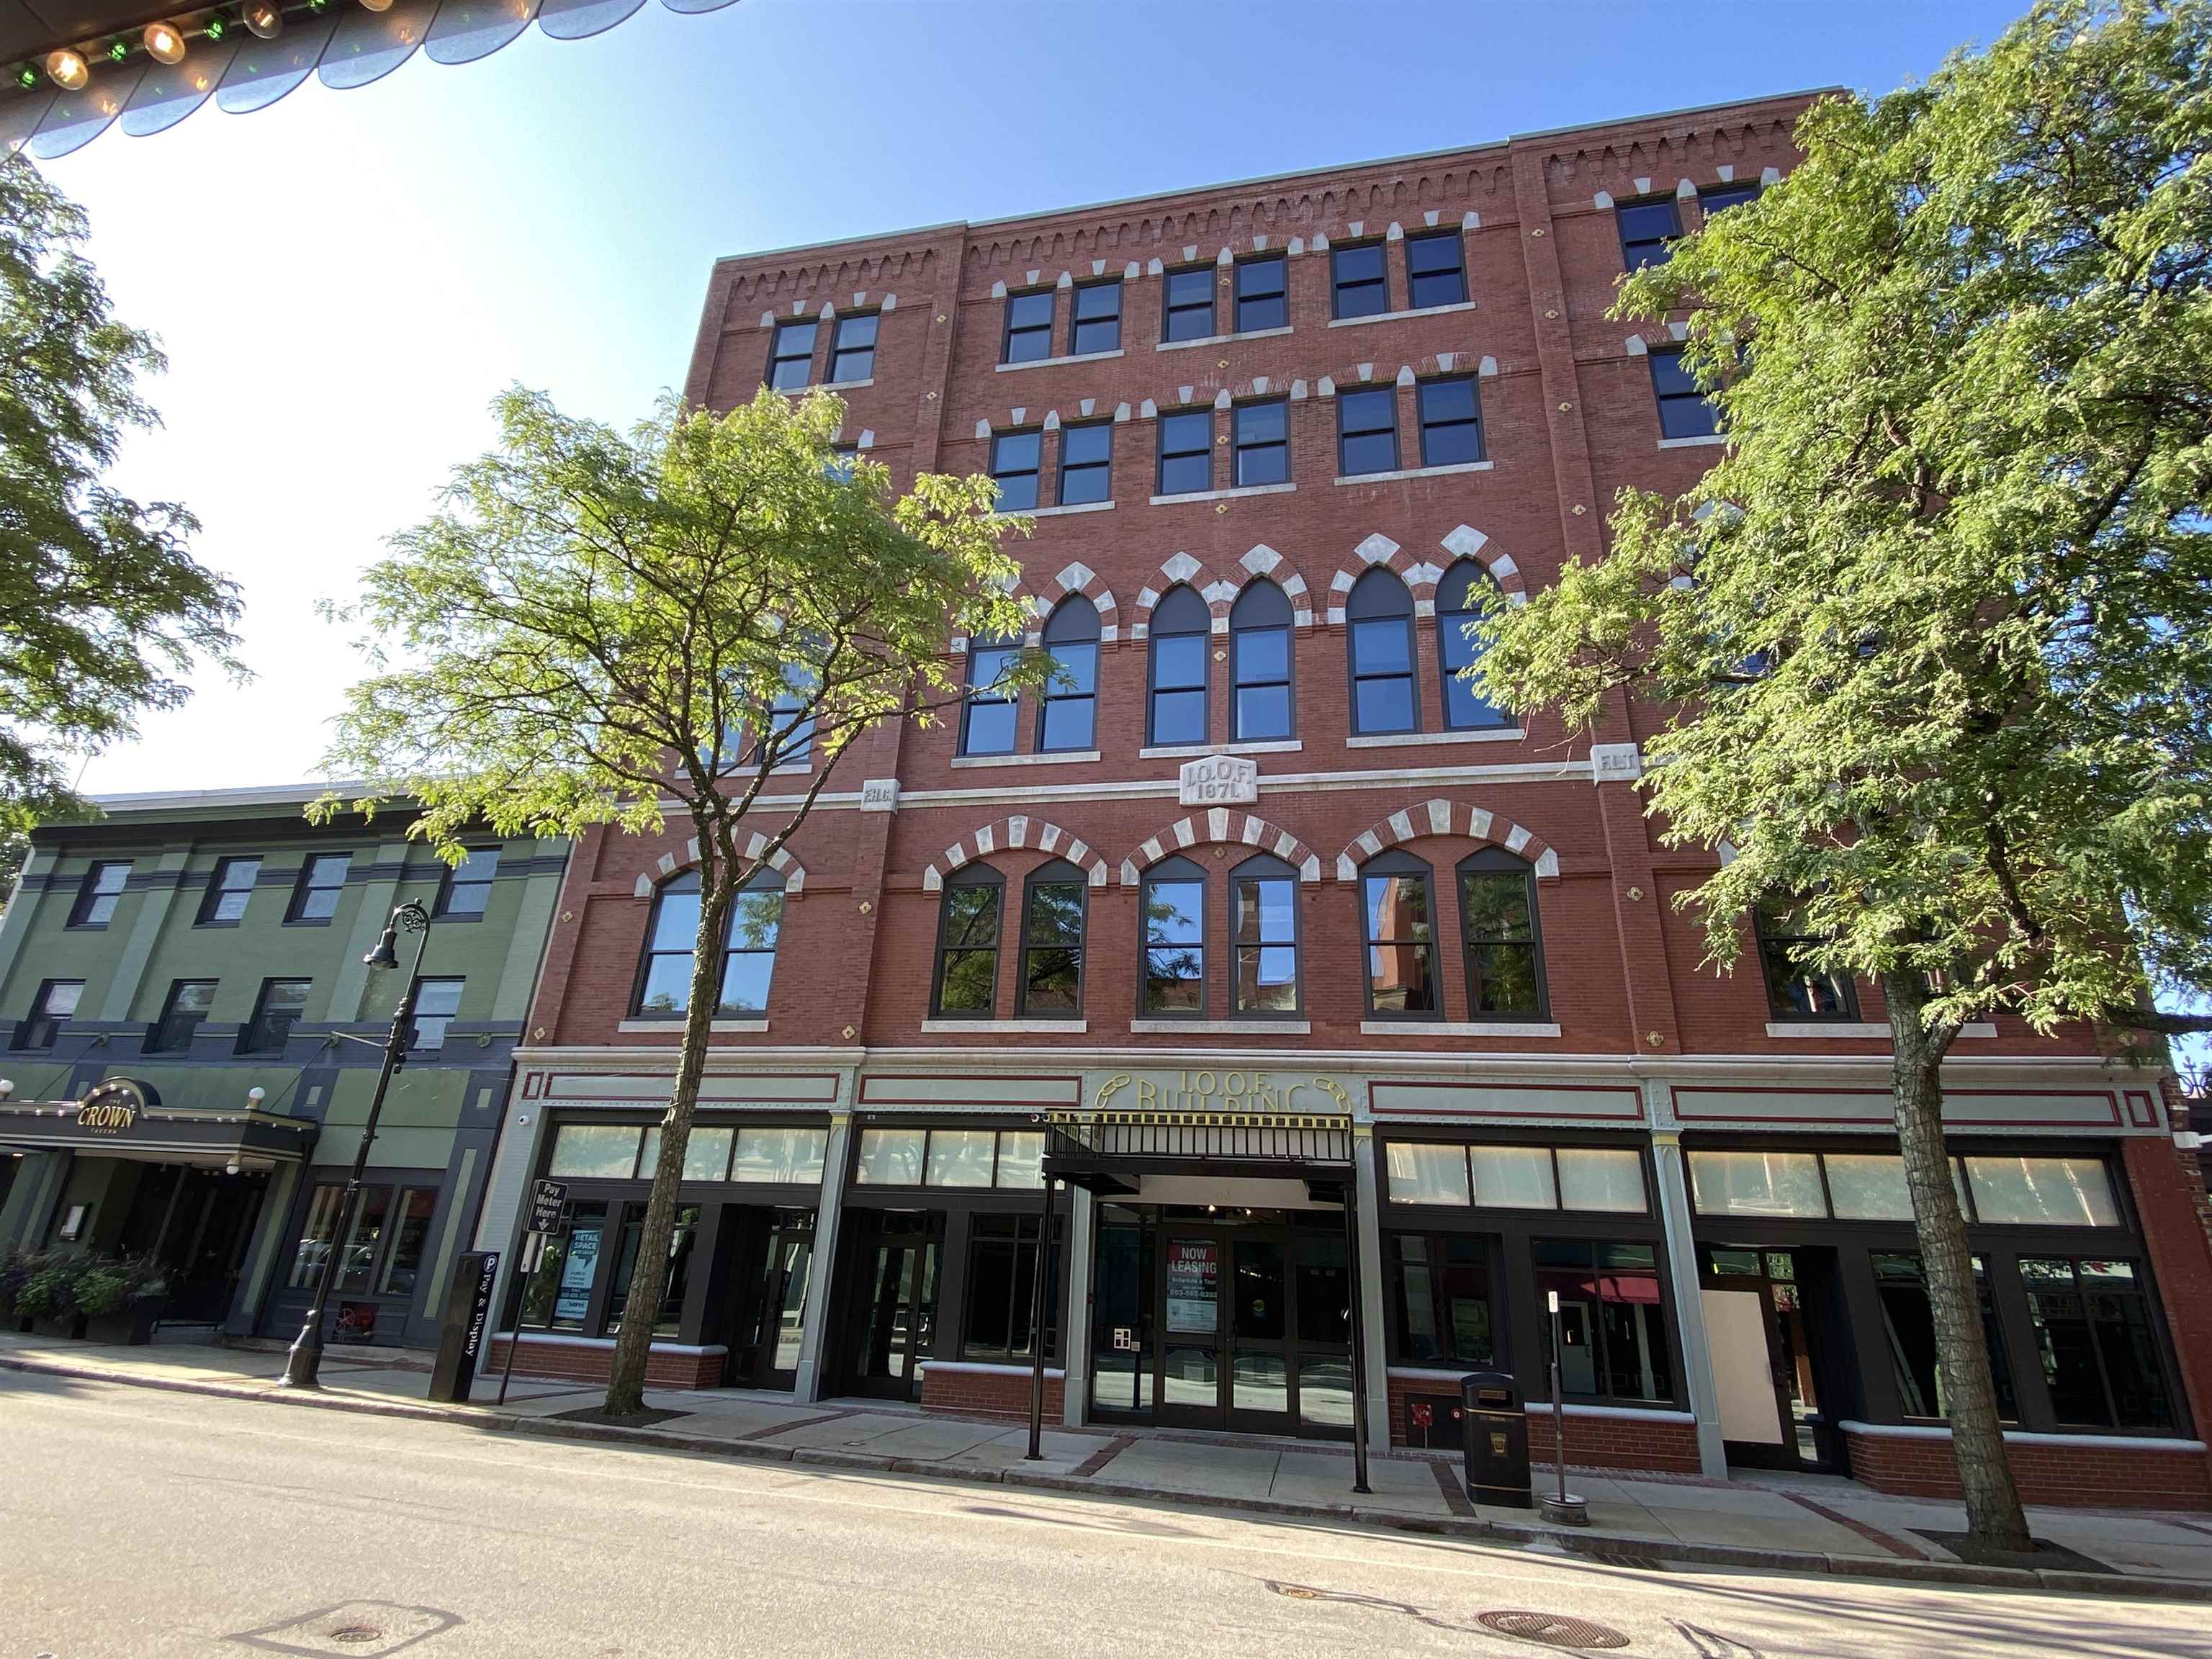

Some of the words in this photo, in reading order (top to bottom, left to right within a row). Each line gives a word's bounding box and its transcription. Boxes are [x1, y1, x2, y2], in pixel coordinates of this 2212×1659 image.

[1180, 1071, 1273, 1097] I.O.O.F.
[77, 1105, 136, 1129] CROWN
[544, 1183, 560, 1197] Pay
[536, 1194, 562, 1208] Meter
[535, 1206, 557, 1218] Here
[575, 1233, 599, 1242] RETAIL
[574, 1241, 597, 1250] SPACE
[1181, 1247, 1208, 1260] NOW
[1172, 1260, 1217, 1274] LEASING
[480, 1274, 491, 1293] Pay
[477, 1298, 486, 1307] &
[465, 1313, 484, 1357] Display
